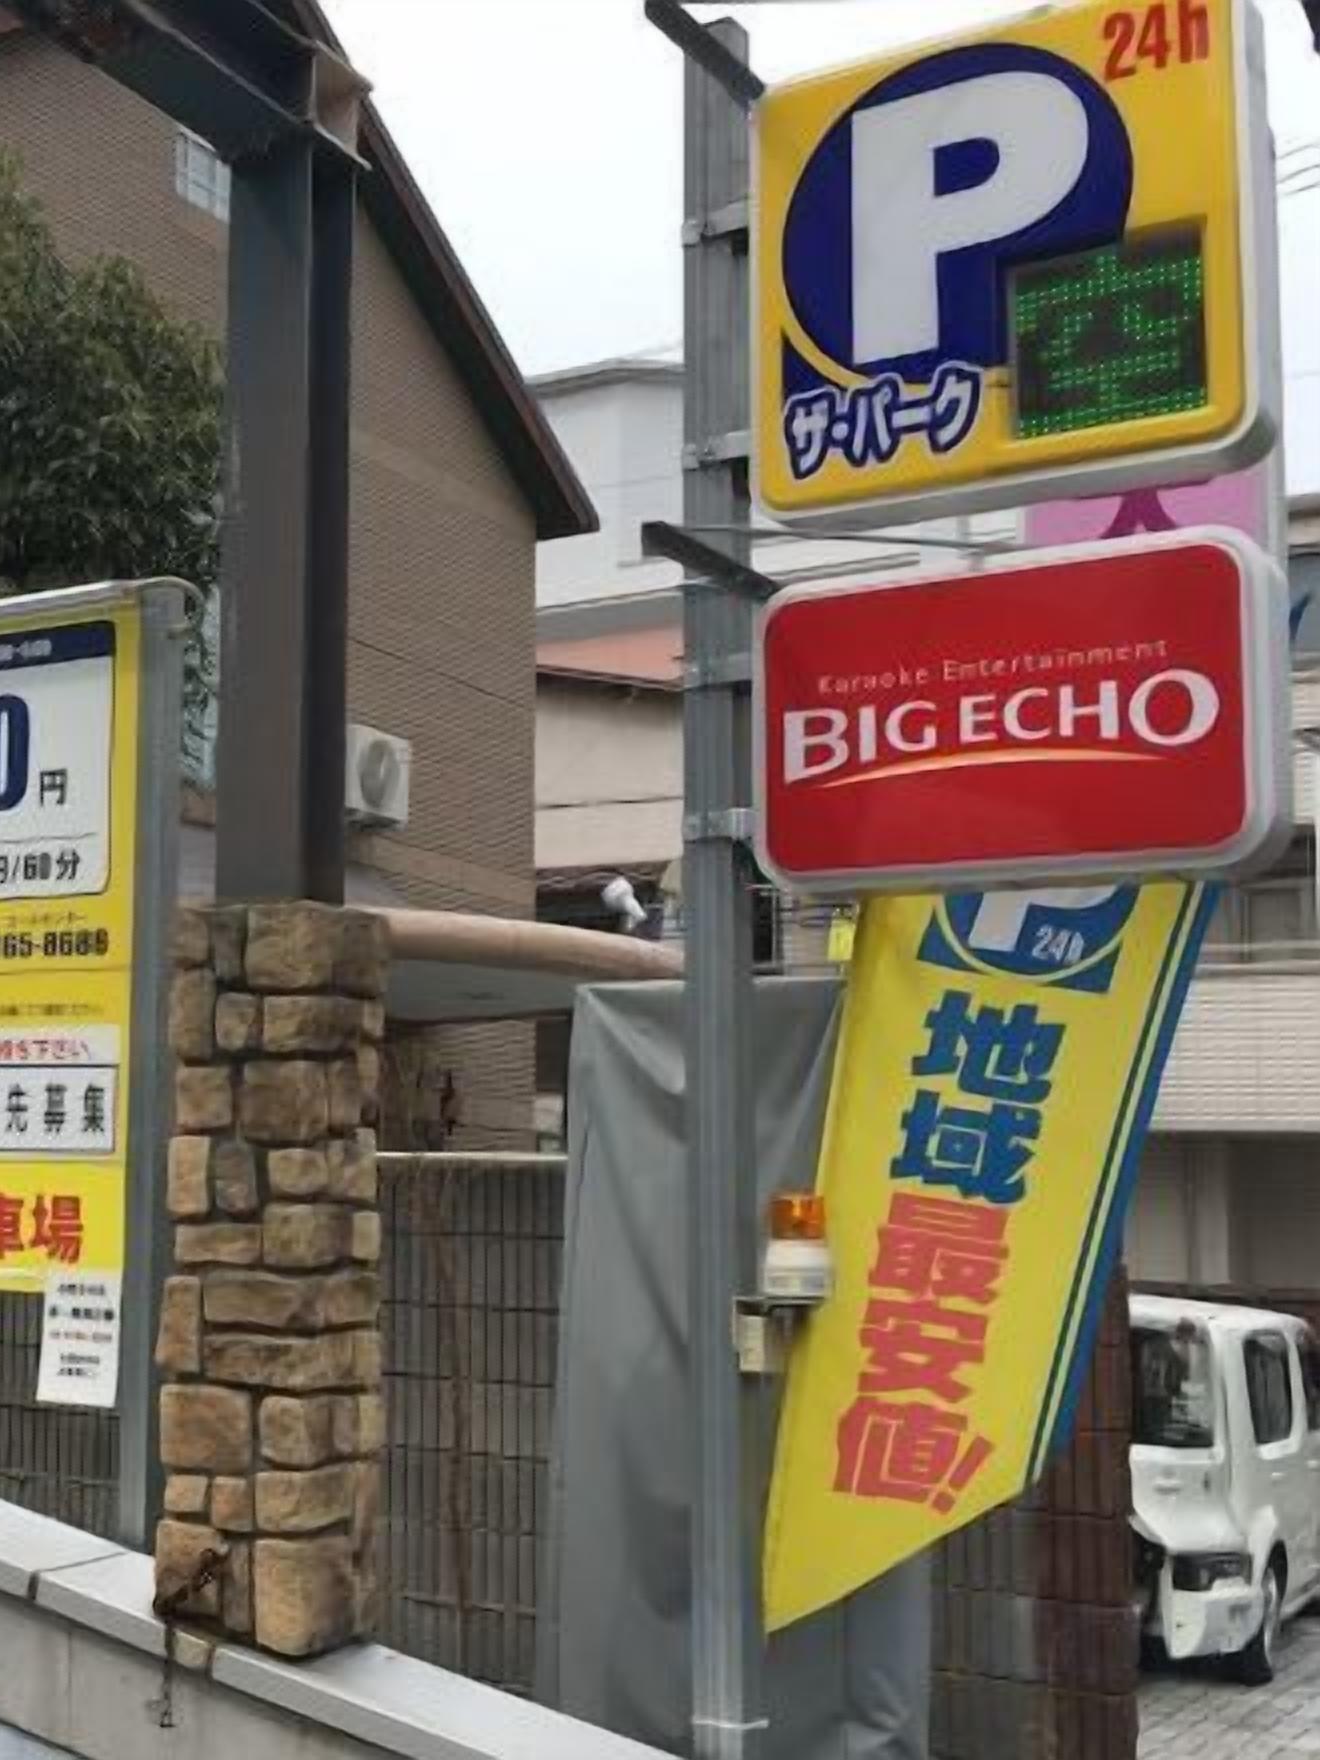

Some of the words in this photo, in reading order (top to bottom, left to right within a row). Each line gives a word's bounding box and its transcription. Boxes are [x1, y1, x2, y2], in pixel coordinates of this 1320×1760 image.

[1103, 0, 1211, 82] 24h
[851, 70, 1089, 366] P
[818, 666, 929, 695] Karaoke
[942, 638, 1168, 683] Entertainment
[783, 699, 938, 785] BIG
[957, 669, 1221, 747] ECHO
